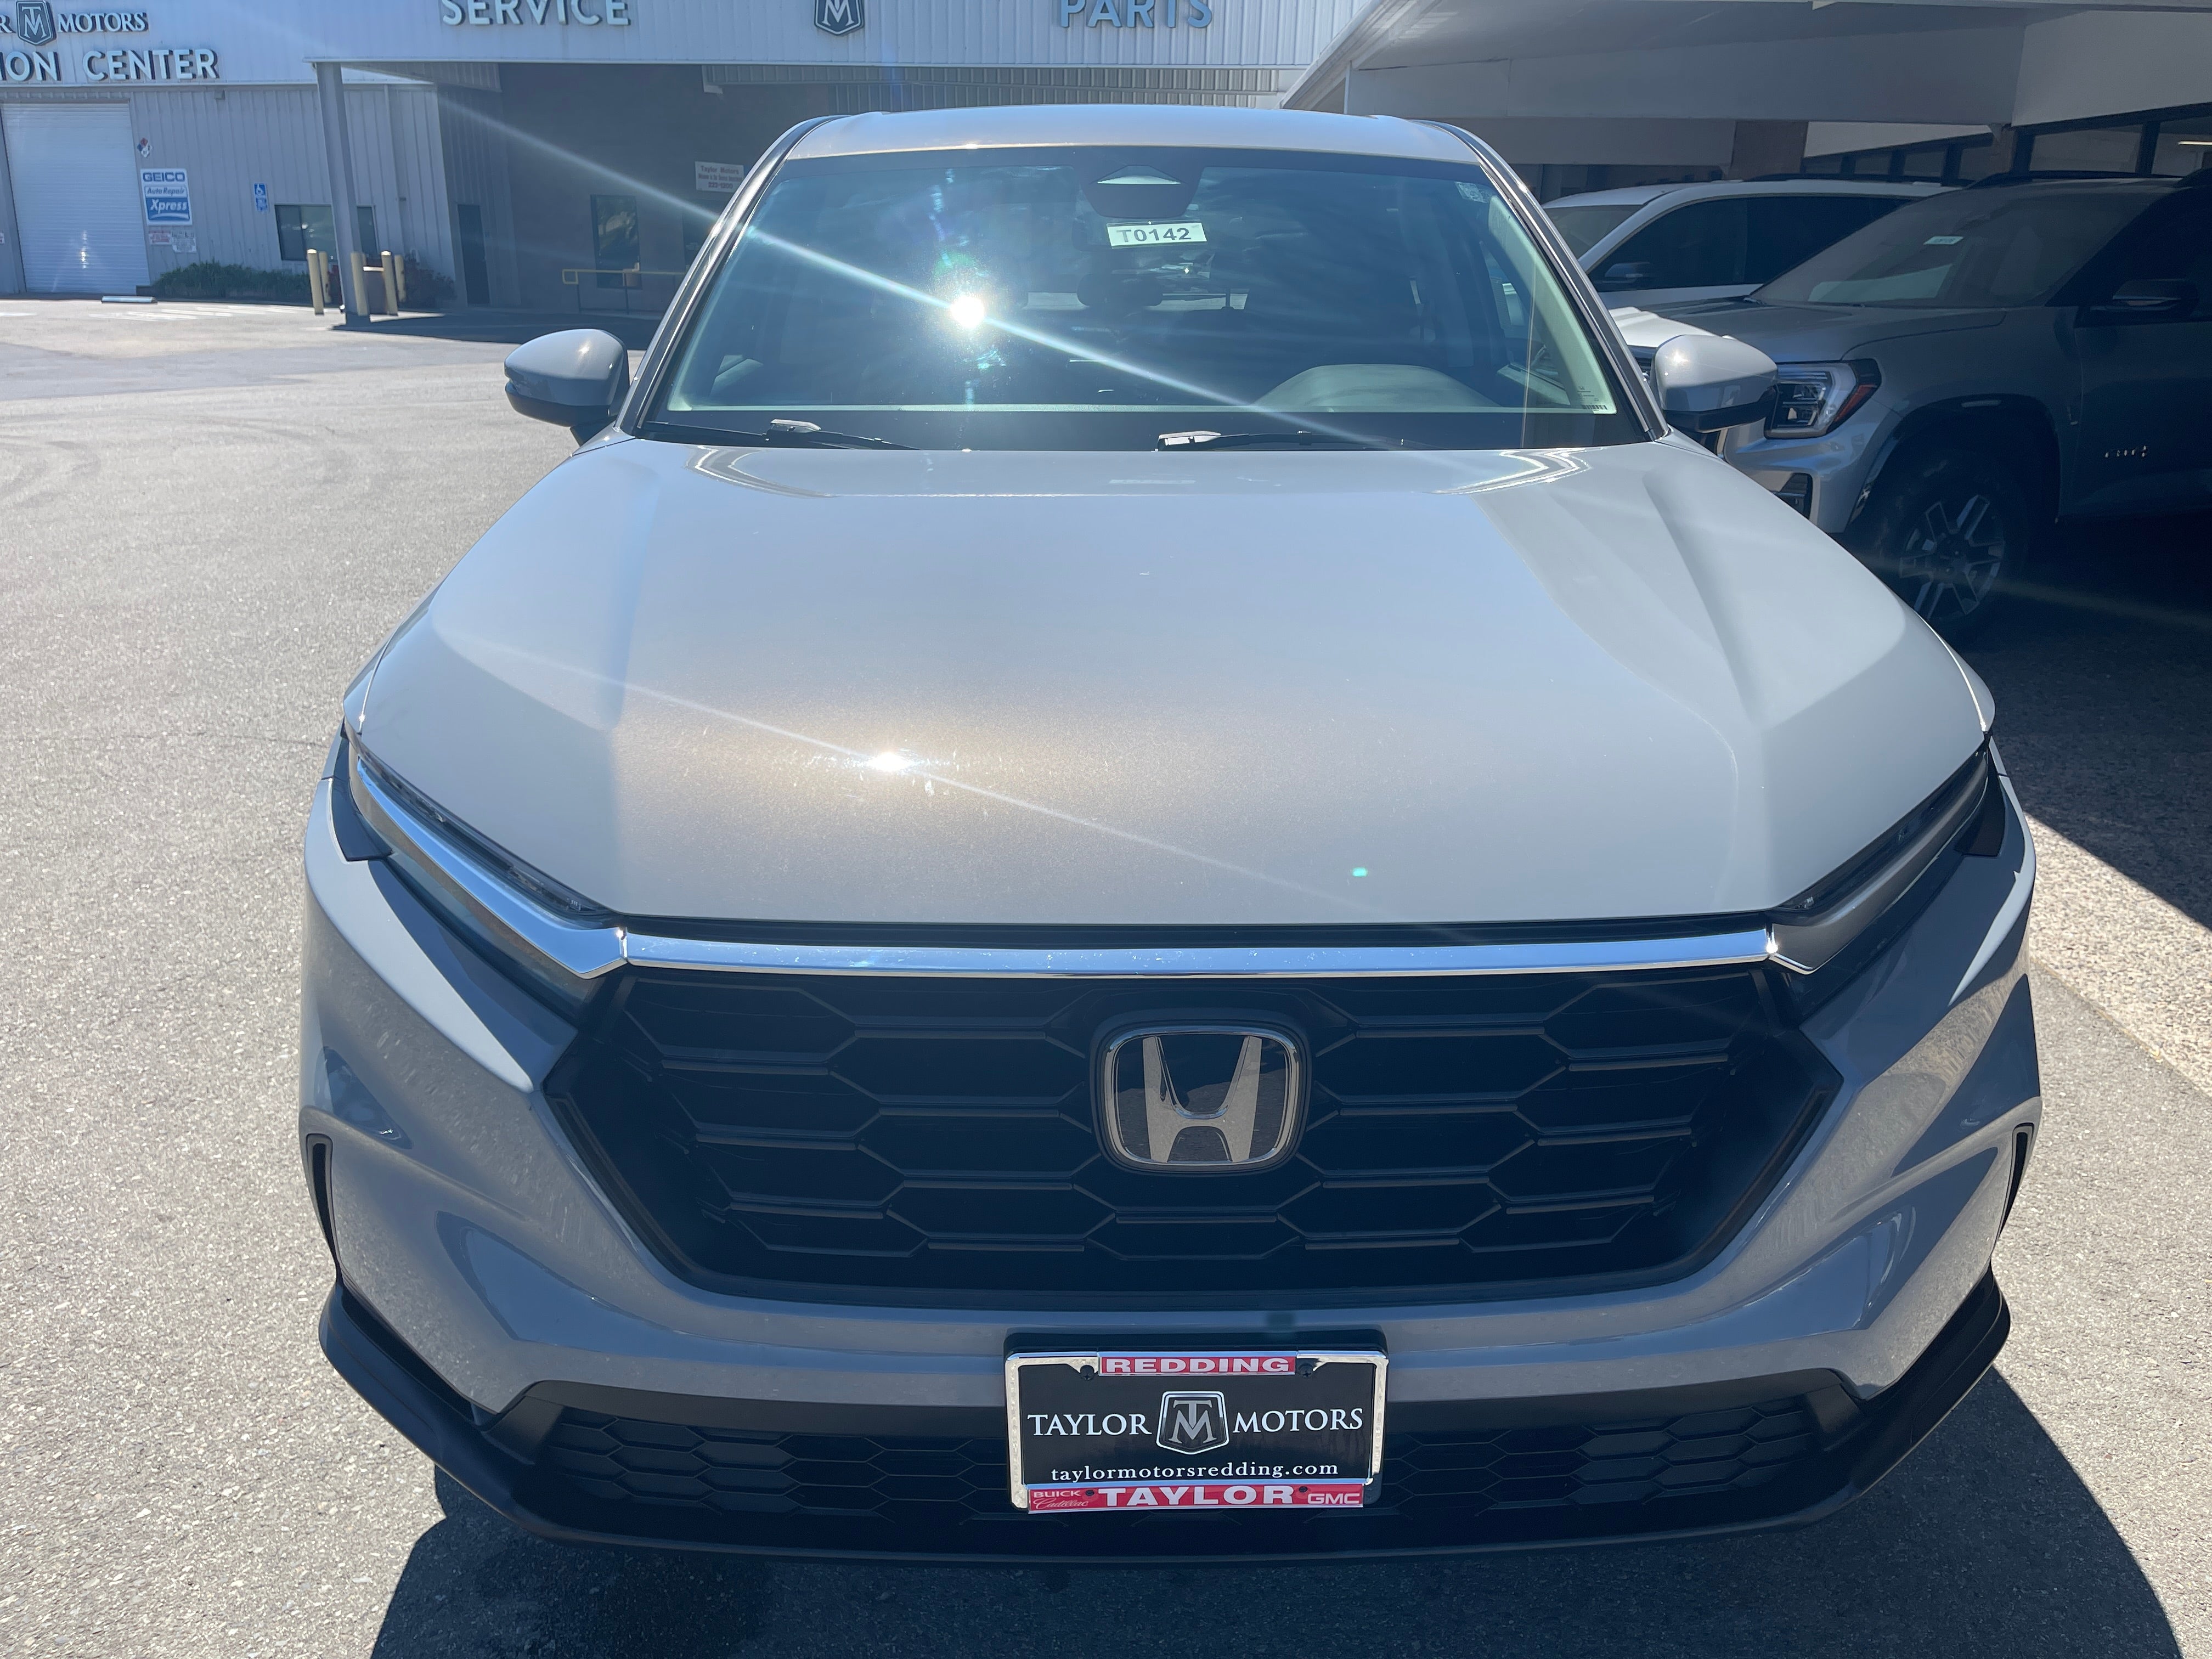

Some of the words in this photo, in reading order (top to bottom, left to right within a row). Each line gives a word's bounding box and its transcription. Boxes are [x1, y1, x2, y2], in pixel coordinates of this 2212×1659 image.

[443, 0, 629, 25] SERVICE
[1061, 0, 1212, 28] PARTS
[58, 12, 147, 33] MOTORS
[83, 48, 218, 81] CENTER
[701, 165, 718, 173] Taylor
[143, 172, 185, 182] GEICO
[163, 187, 184, 196] Repair
[150, 199, 187, 214] Xpress
[1116, 228, 1192, 242] T0142
[1106, 1358, 1289, 1373] REDDING
[1027, 1414, 1152, 1436] TAYLOR
[1233, 1408, 1363, 1434] MOTORS
[1051, 1462, 1339, 1483] taylormotorsredding.com
[1098, 1485, 1294, 1506] TAYLOR
[1308, 1493, 1360, 1505] GMC
[1033, 1498, 1089, 1509] Cadillac
